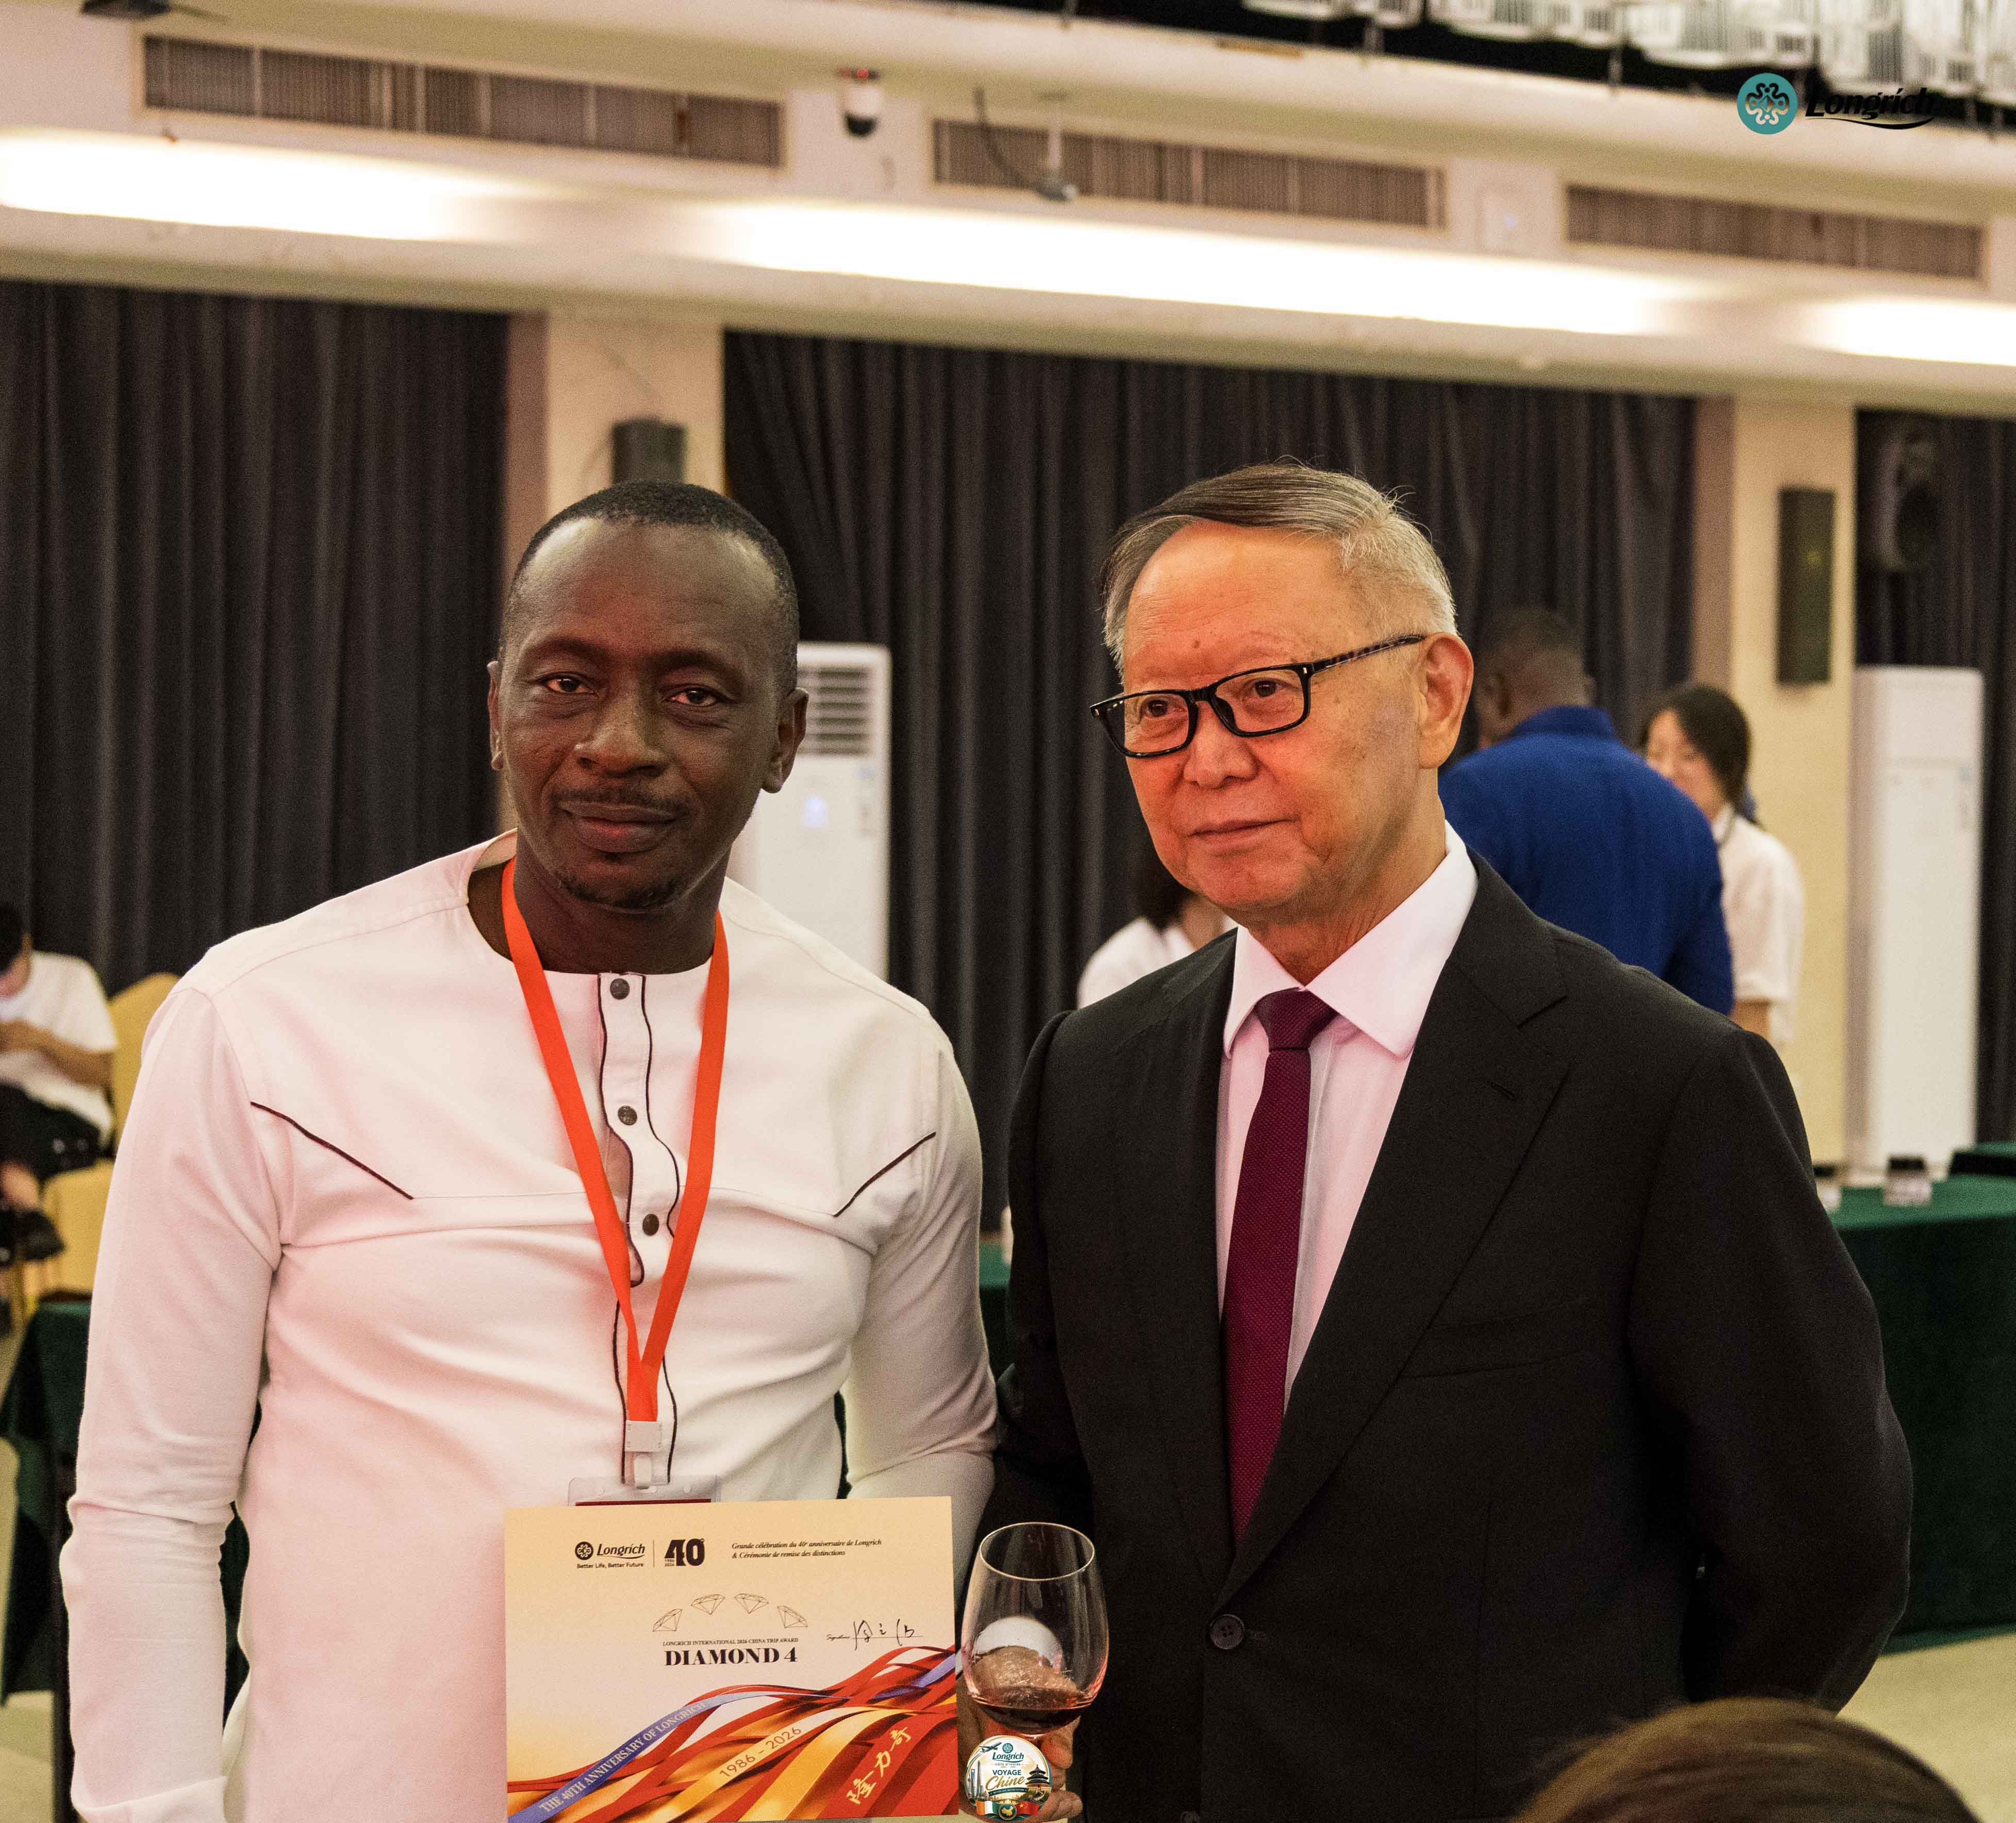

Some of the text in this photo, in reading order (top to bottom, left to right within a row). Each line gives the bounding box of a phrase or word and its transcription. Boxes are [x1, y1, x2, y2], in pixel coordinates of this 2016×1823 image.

[854, 1539, 882, 1547] Longrich
[664, 1647, 798, 1666] DIAMOND 4
[540, 1796, 564, 1812] THE
[561, 1781, 586, 1800] 40TH
[584, 1737, 645, 1785] ANNIVERSARY
[643, 1728, 656, 1742] OF
[719, 1754, 755, 1778] 1986
[765, 1727, 801, 1750] 2026
